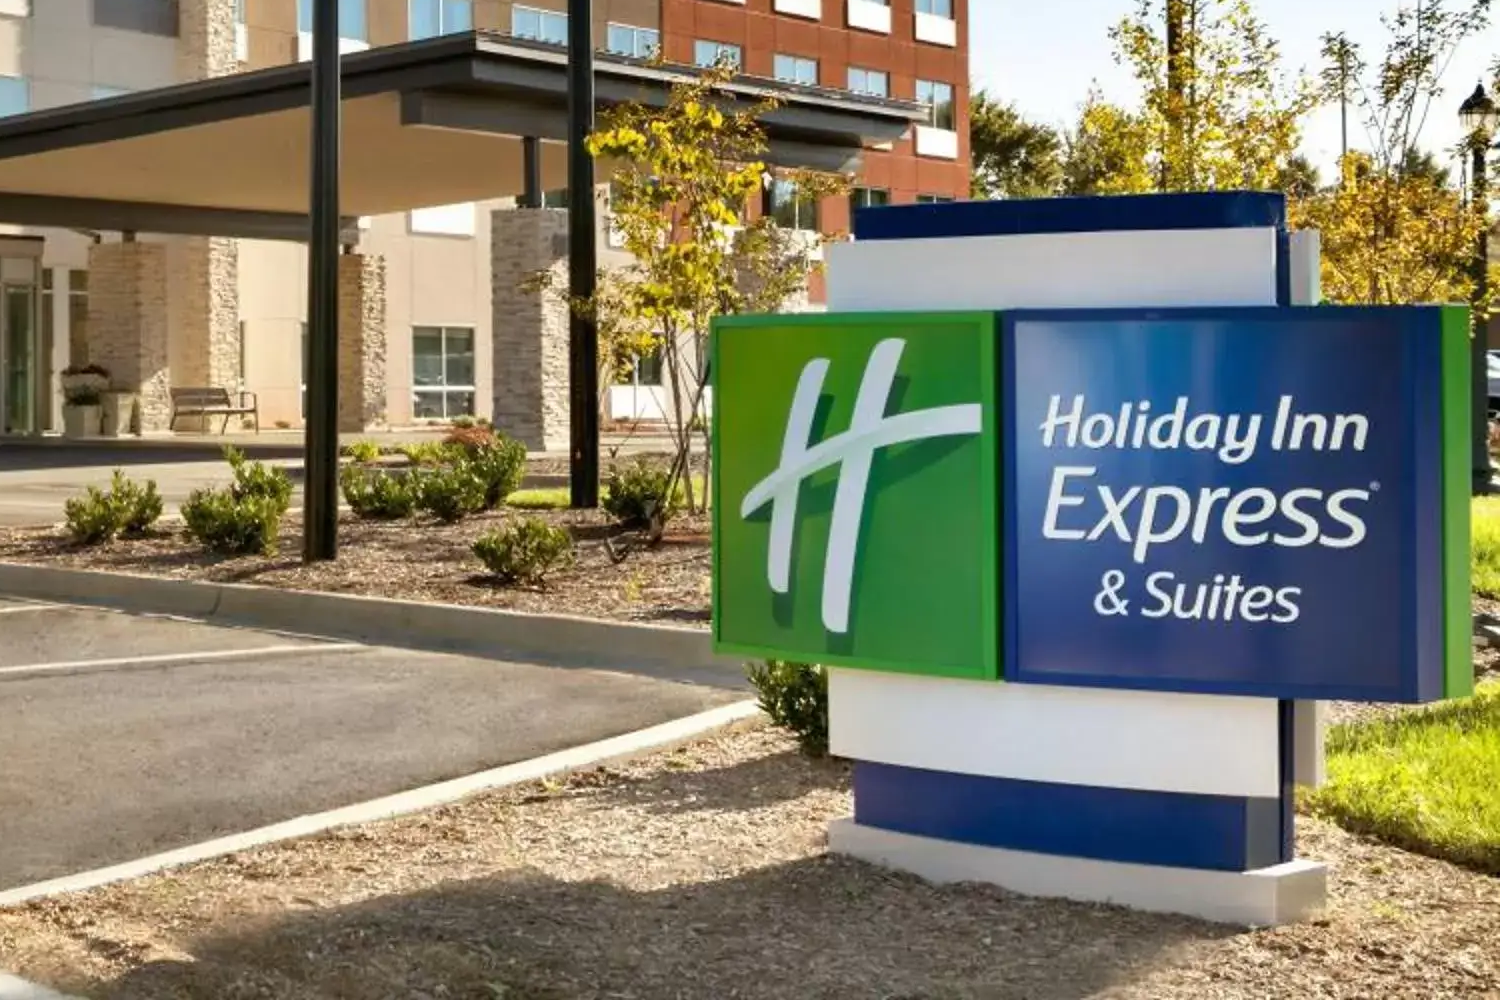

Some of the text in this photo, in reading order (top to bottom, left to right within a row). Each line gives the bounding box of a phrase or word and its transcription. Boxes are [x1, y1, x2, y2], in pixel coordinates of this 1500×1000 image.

[1040, 393, 1370, 464] Holiday Inn
[1093, 569, 1302, 623] & Suites
